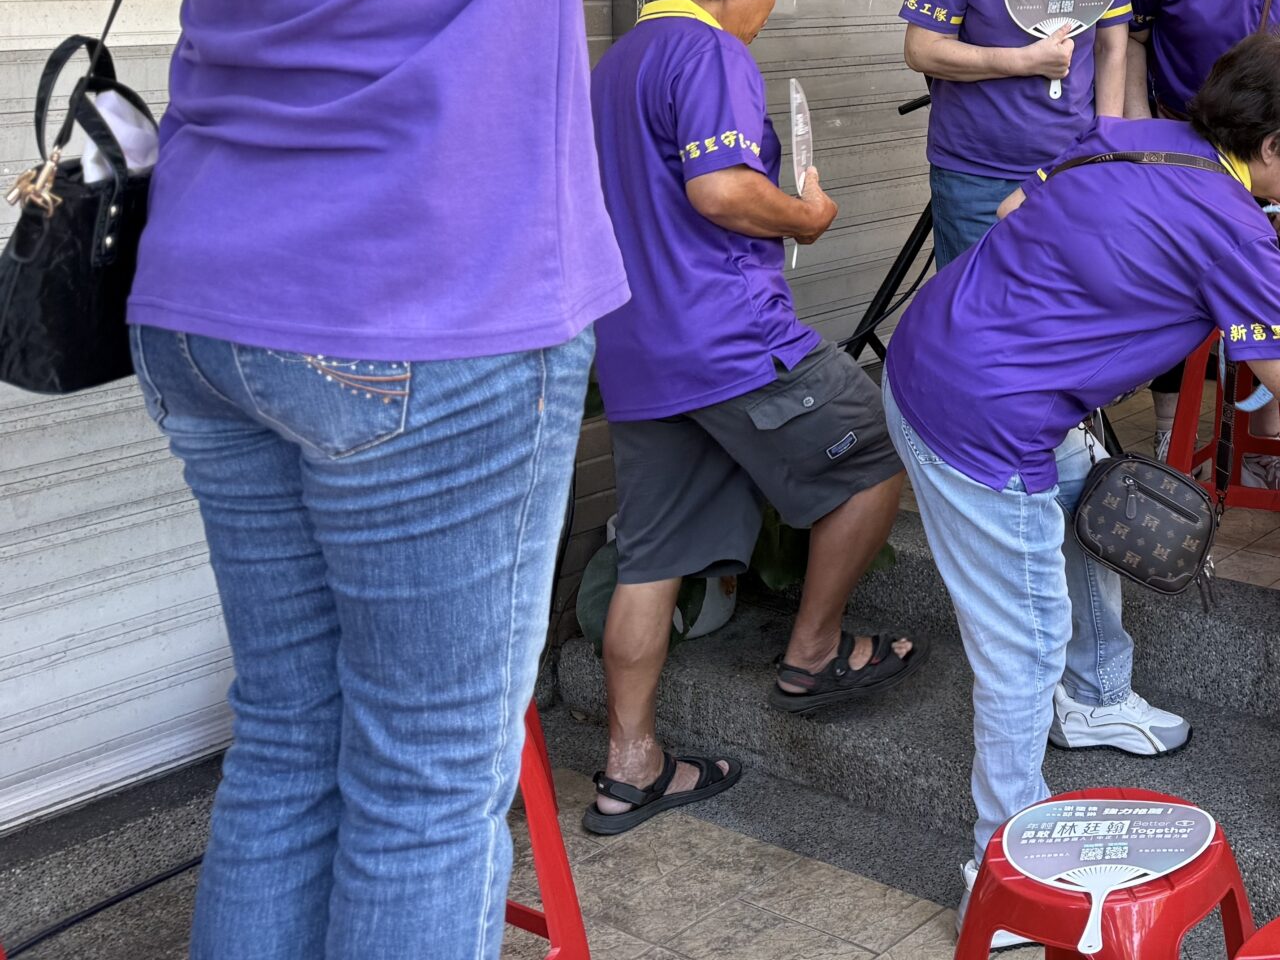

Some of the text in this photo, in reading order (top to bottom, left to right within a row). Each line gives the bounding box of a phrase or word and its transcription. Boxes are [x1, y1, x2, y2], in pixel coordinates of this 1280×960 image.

[1057, 821, 1126, 837] 林廷翰
[1131, 827, 1195, 836] Together
